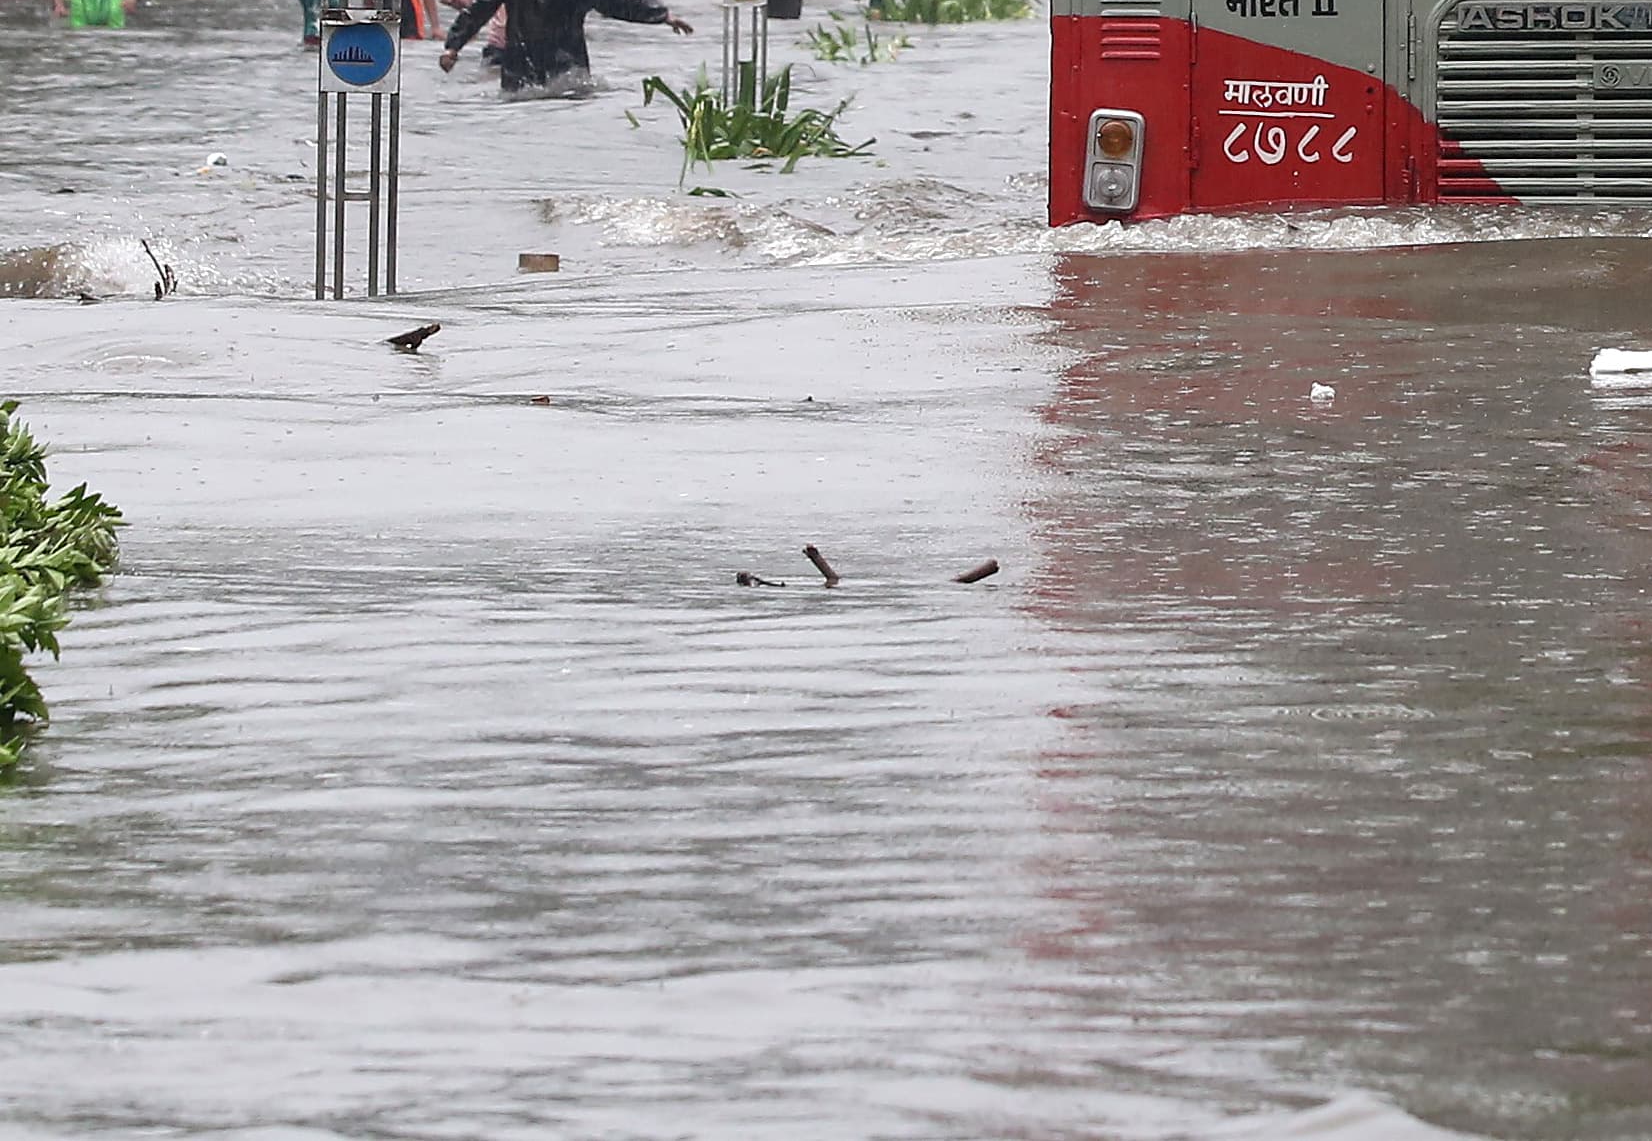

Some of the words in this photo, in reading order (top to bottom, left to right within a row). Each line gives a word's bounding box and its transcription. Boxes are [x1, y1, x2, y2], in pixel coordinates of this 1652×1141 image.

[1460, 3, 1631, 30] ASHOK
[1224, 75, 1329, 107] मालवणी
[1223, 122, 1357, 165] ८७८८
